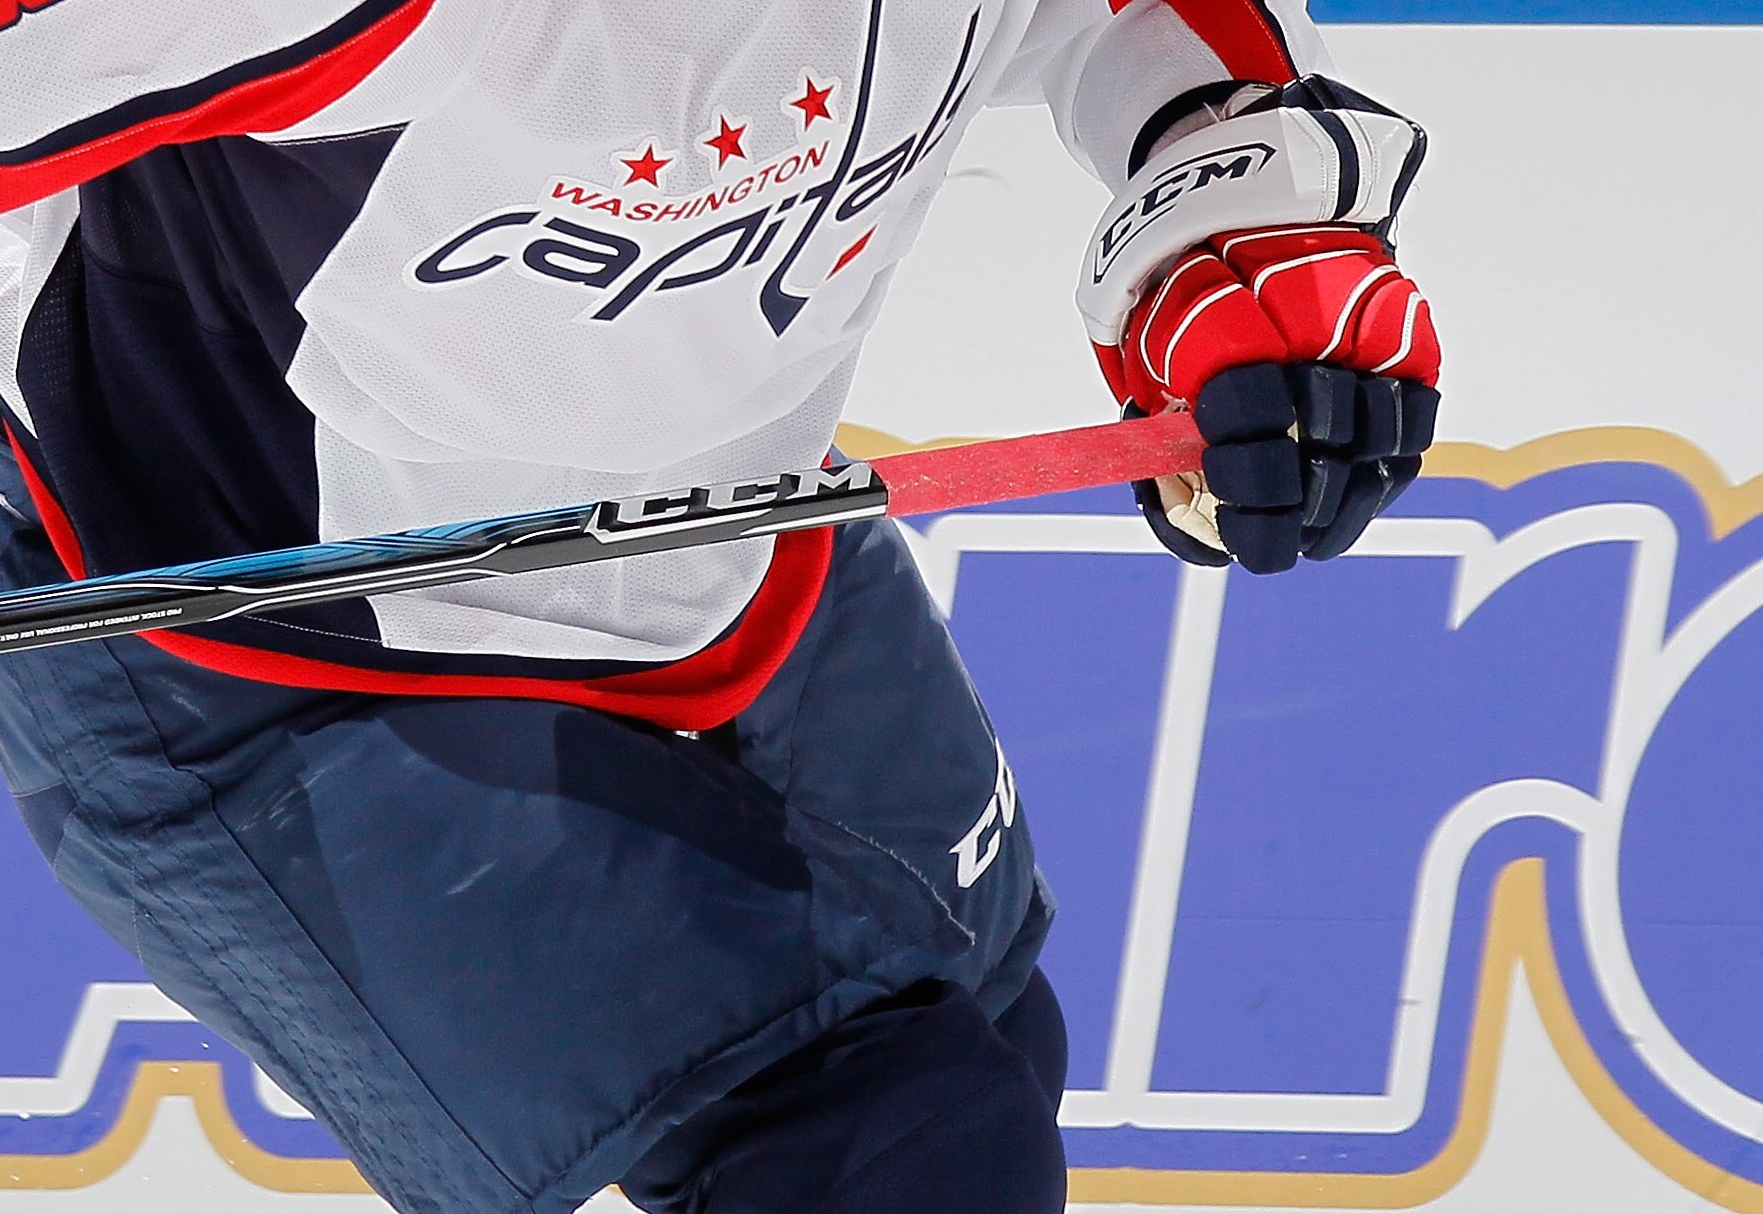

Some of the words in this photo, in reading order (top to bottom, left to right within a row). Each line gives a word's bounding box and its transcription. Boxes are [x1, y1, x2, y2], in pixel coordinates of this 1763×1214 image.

[549, 139, 831, 224] WASHINGTON
[1099, 152, 1253, 258] CCM
[614, 461, 875, 526] CCM
